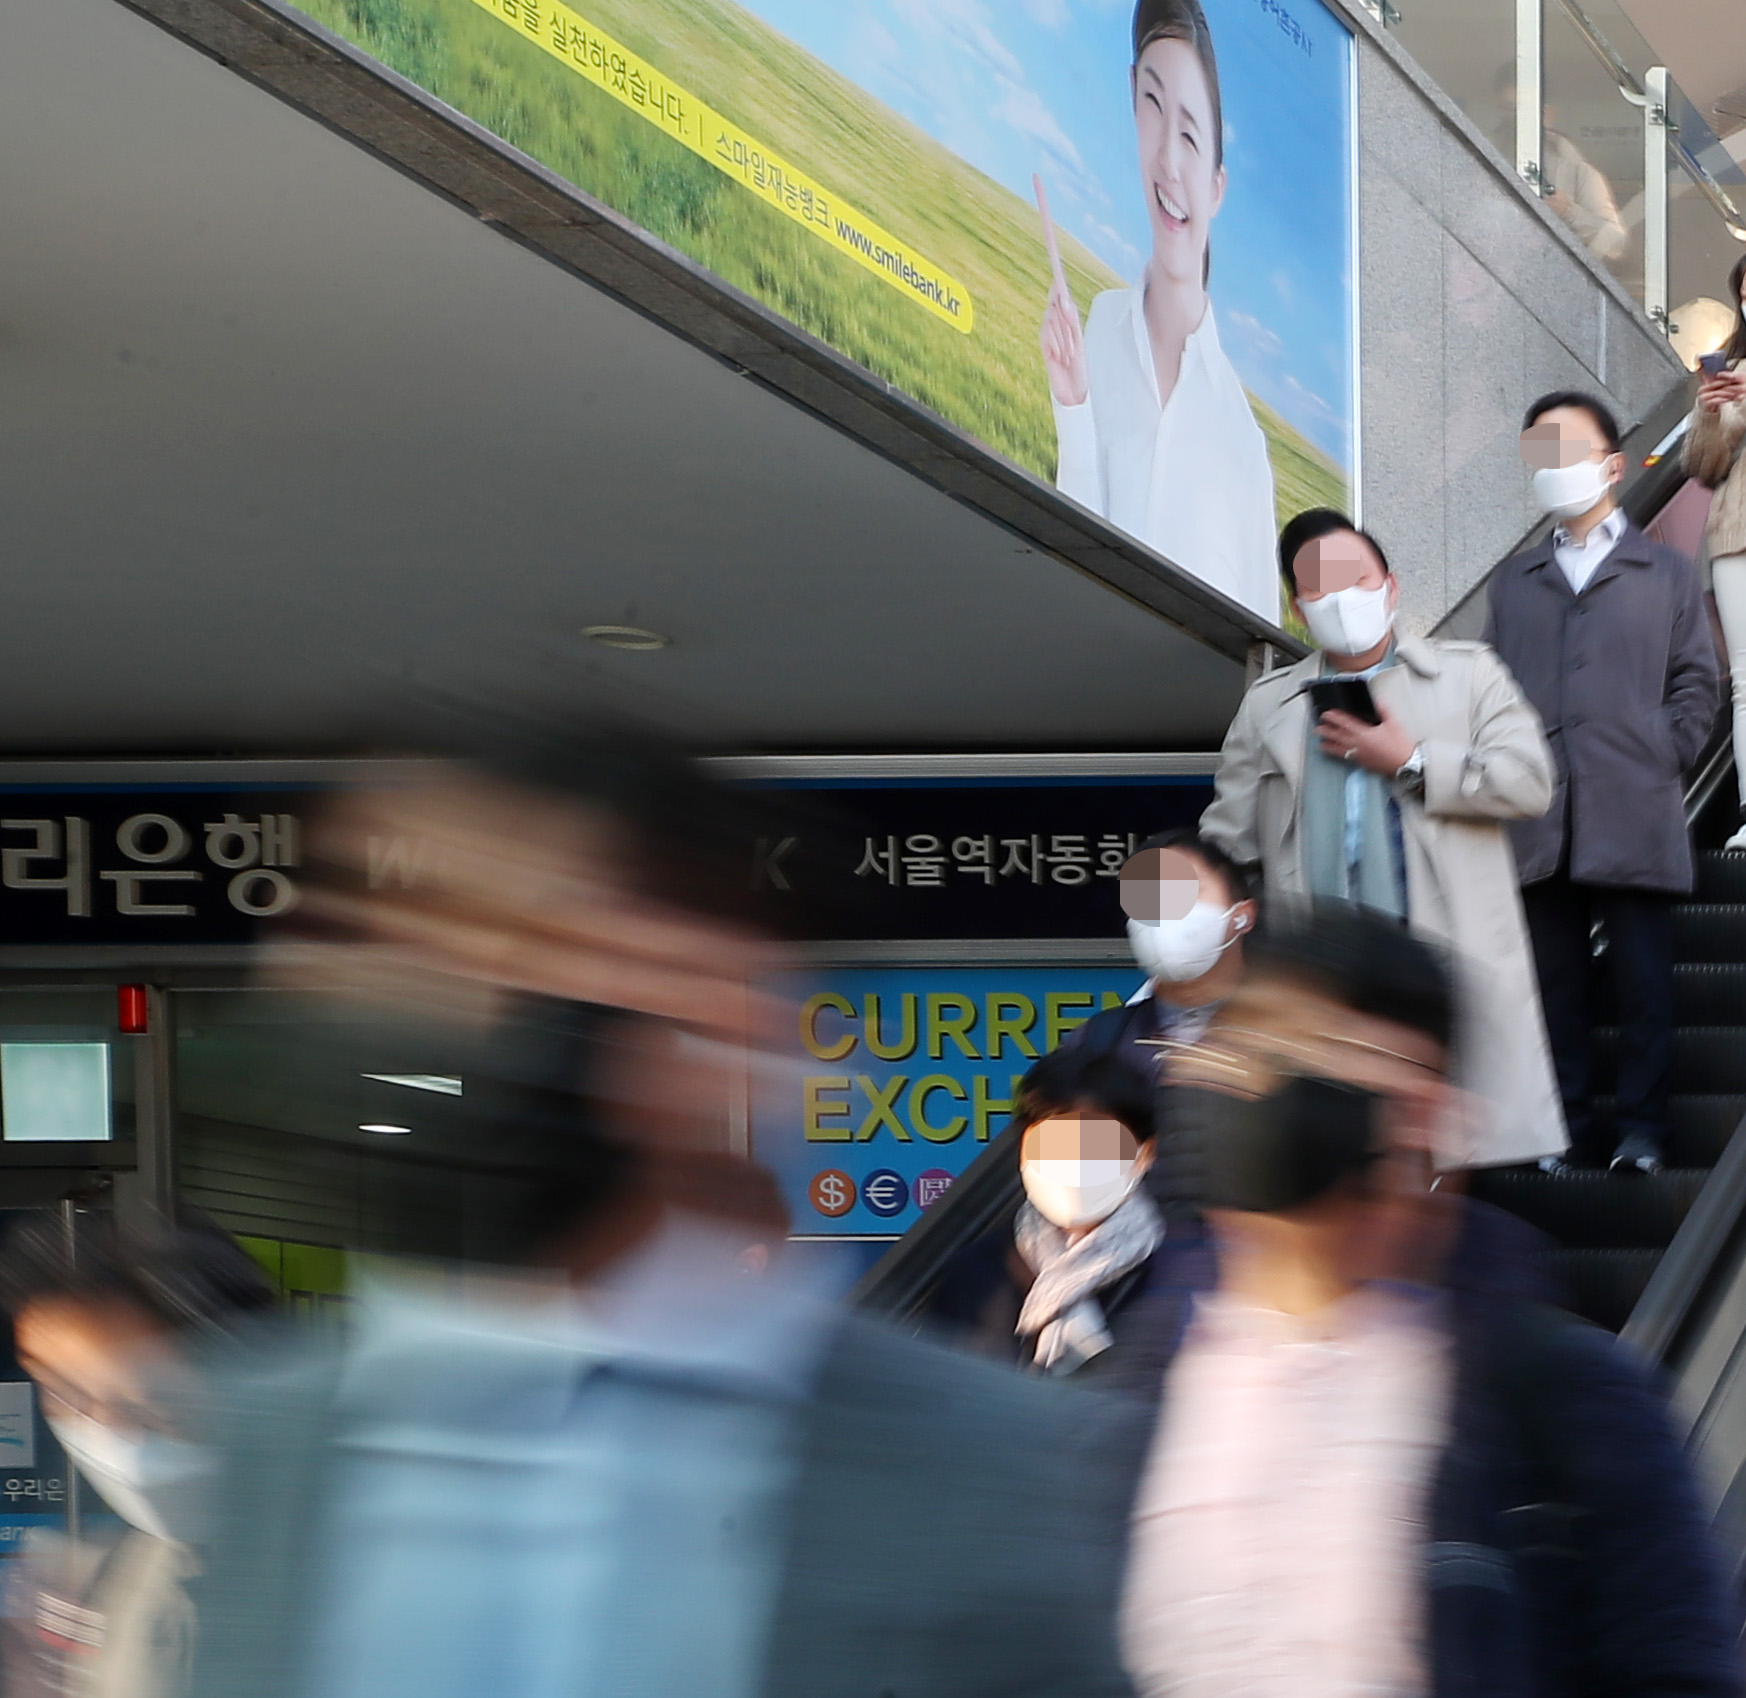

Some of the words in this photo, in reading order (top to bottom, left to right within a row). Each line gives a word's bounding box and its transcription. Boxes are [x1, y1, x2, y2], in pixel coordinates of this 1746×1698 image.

[549, 11, 690, 135] 실천하였습니다.
[715, 130, 830, 228] 스마일재능뱅크
[834, 217, 961, 317] www.smilebank.kr
[801, 991, 1122, 1062] CURRE
